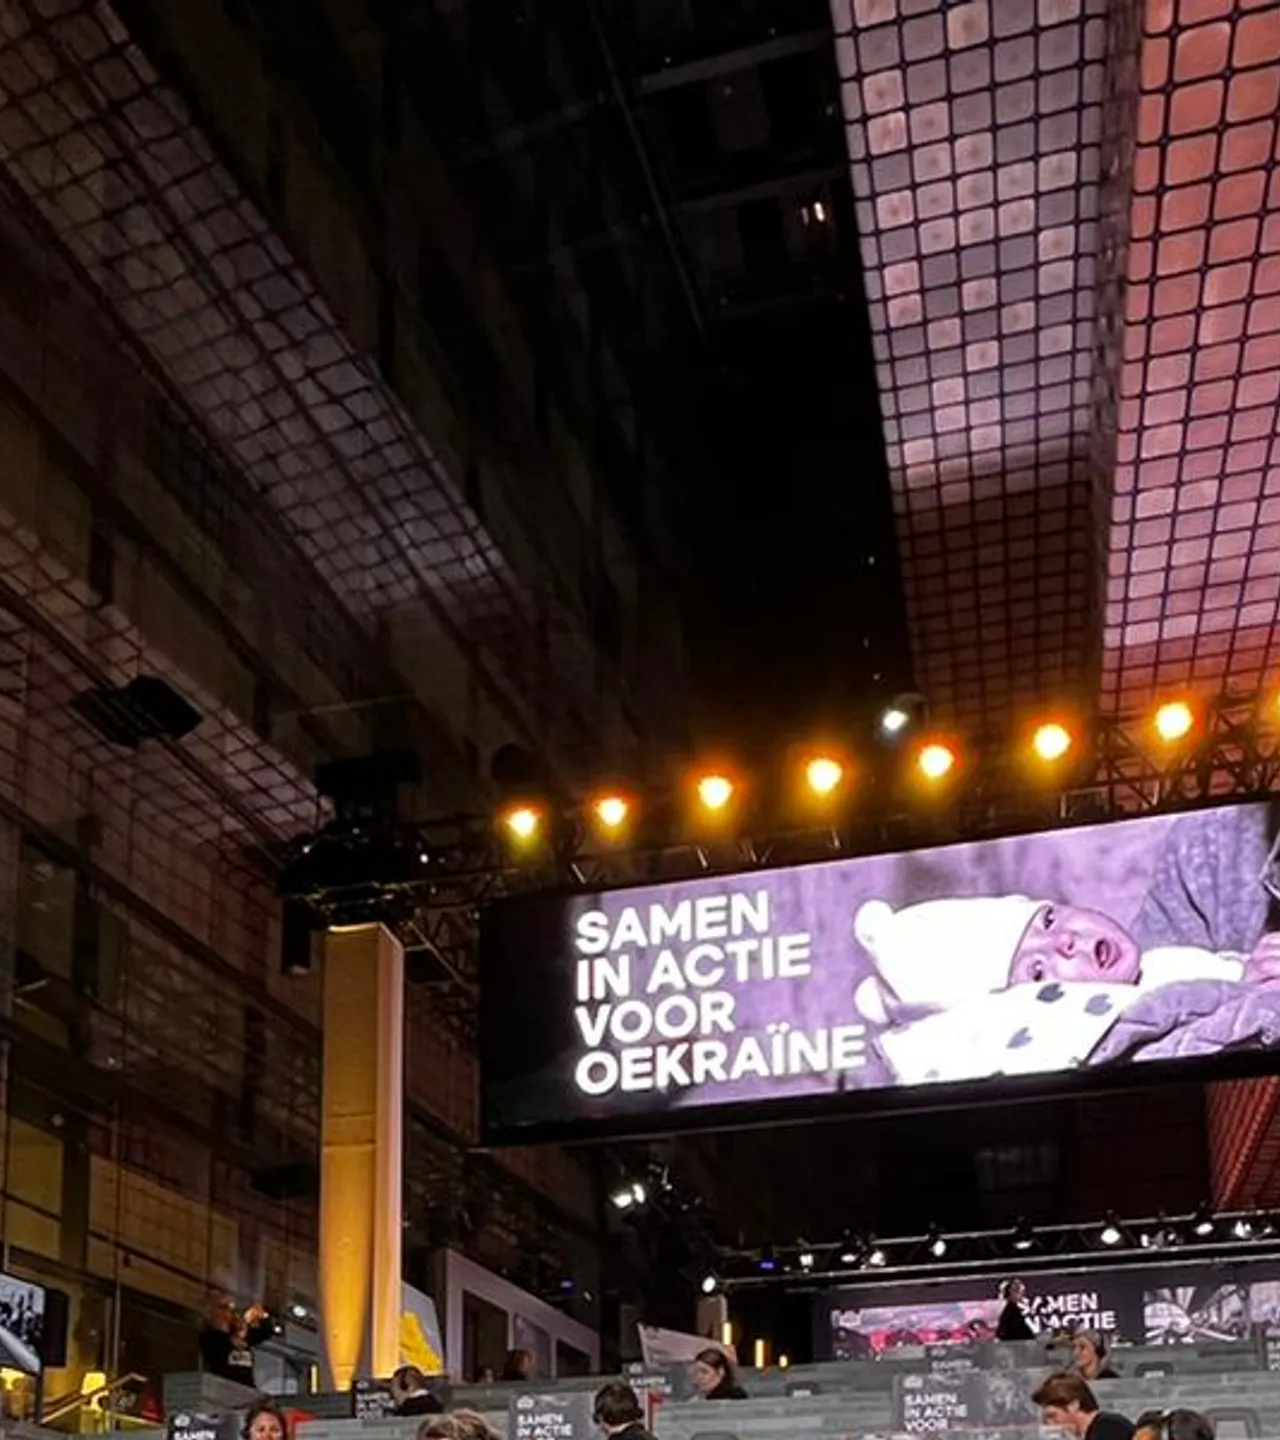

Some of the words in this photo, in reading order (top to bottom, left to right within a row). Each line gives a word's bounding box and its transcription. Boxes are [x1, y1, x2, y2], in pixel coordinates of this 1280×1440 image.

[575, 890, 768, 954] SAMEN
[577, 955, 630, 1001] IN
[646, 934, 811, 994] ACTIE
[574, 991, 735, 1047] VOOR
[575, 1022, 867, 1094] OEKRAÏNE
